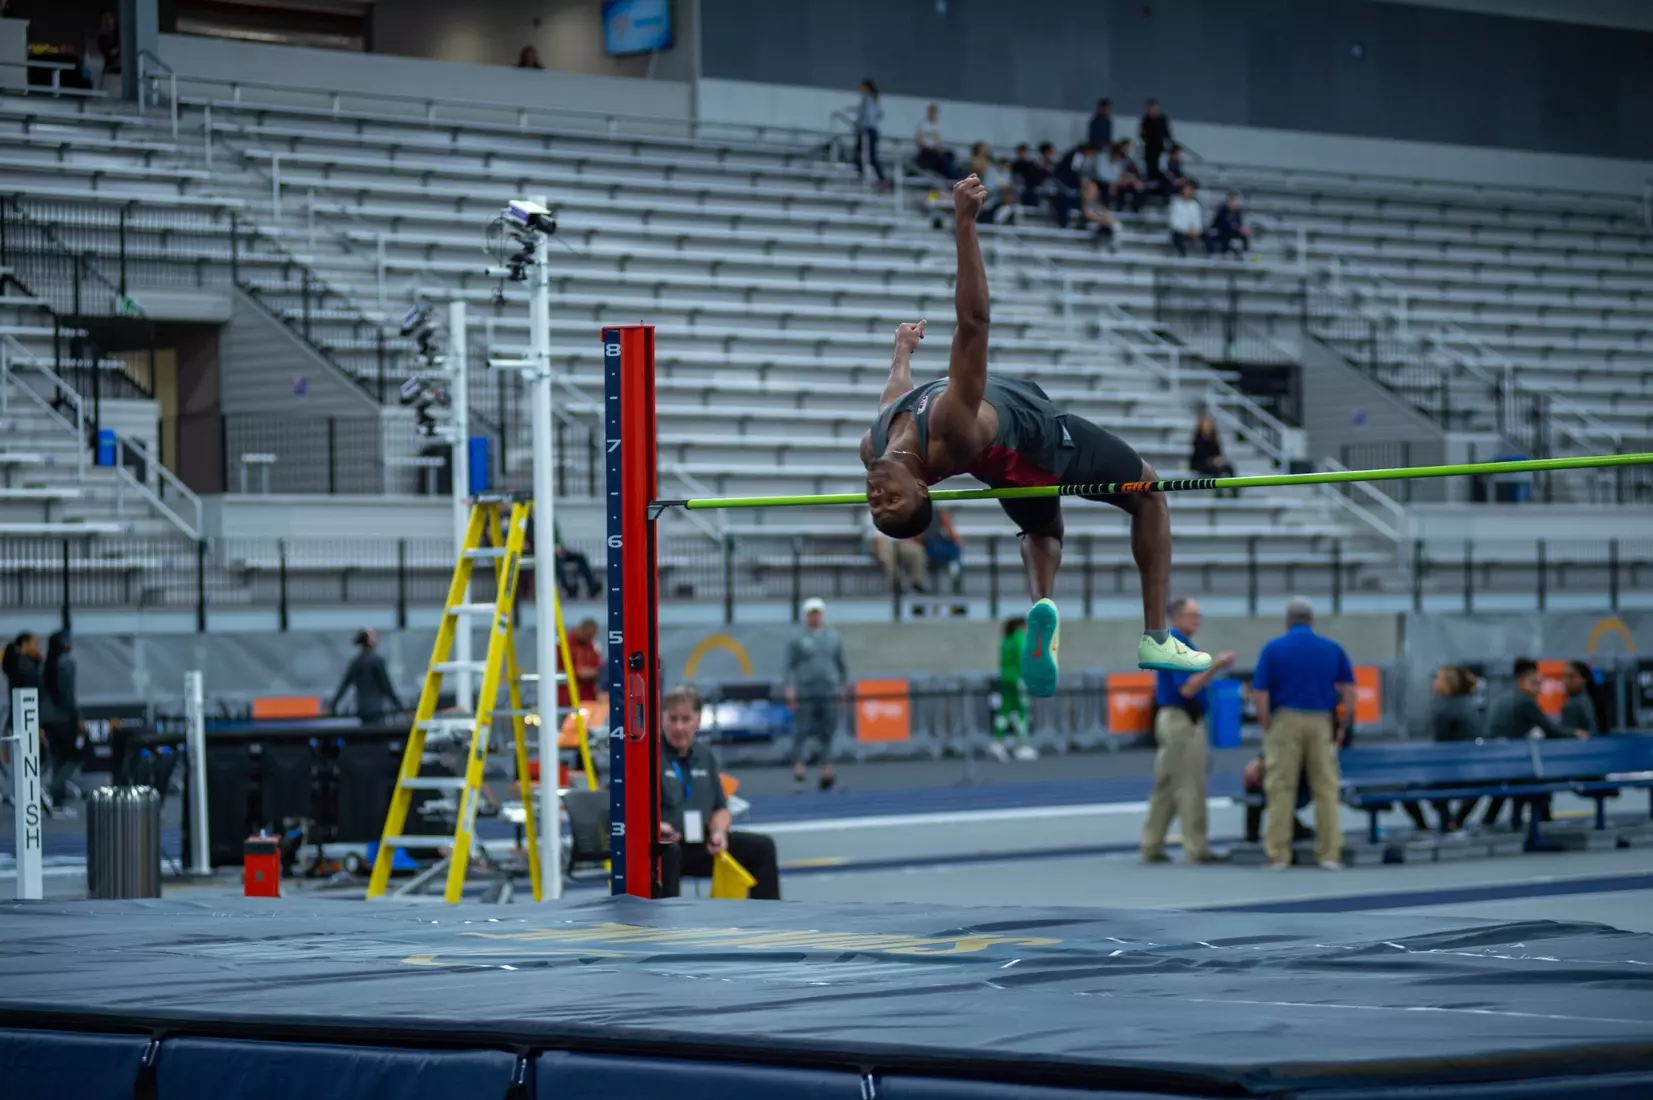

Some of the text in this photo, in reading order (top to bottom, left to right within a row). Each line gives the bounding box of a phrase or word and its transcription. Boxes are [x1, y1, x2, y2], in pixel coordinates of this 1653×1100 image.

[605, 343, 622, 357] 8
[606, 439, 622, 453] 7
[607, 535, 623, 549] 6
[608, 630, 624, 645] 5
[609, 726, 625, 740] 4
[24, 709, 40, 850] FINISH
[611, 822, 626, 836] 3
